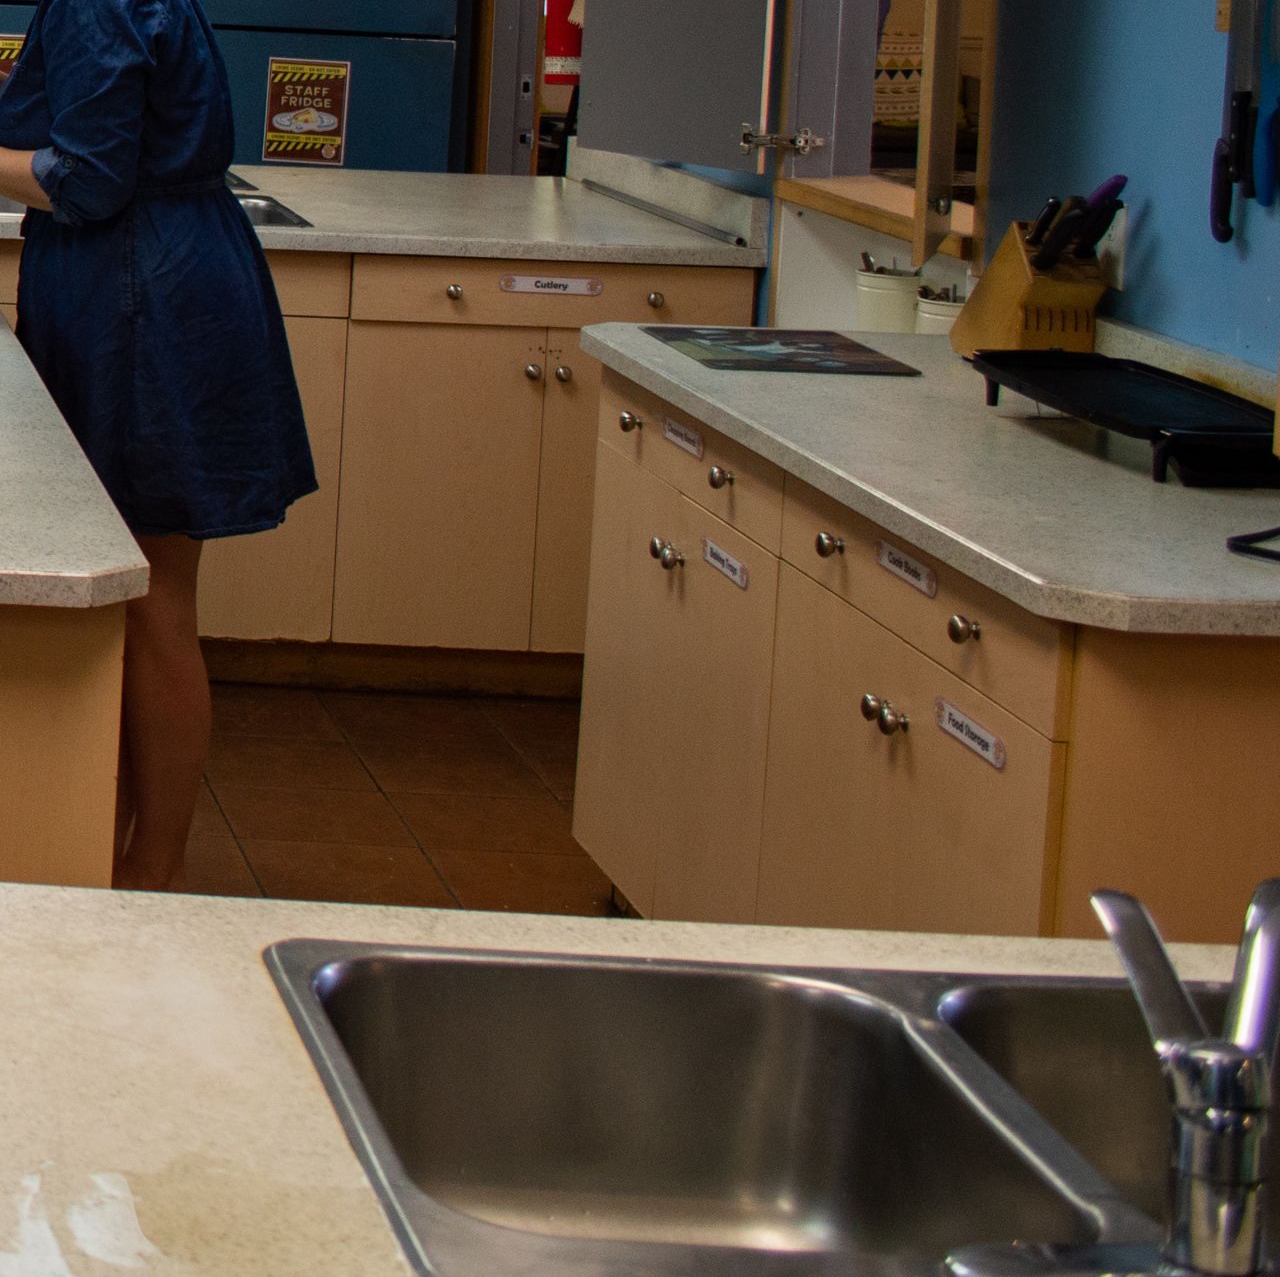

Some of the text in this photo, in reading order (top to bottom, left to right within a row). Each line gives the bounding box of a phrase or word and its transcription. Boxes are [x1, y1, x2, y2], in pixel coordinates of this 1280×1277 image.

[285, 85, 330, 96] STAFF
[281, 96, 332, 108] FRIDGE
[534, 281, 568, 291] Cutlery
[888, 551, 903, 570] Cook
[948, 712, 989, 752] Food Storage
